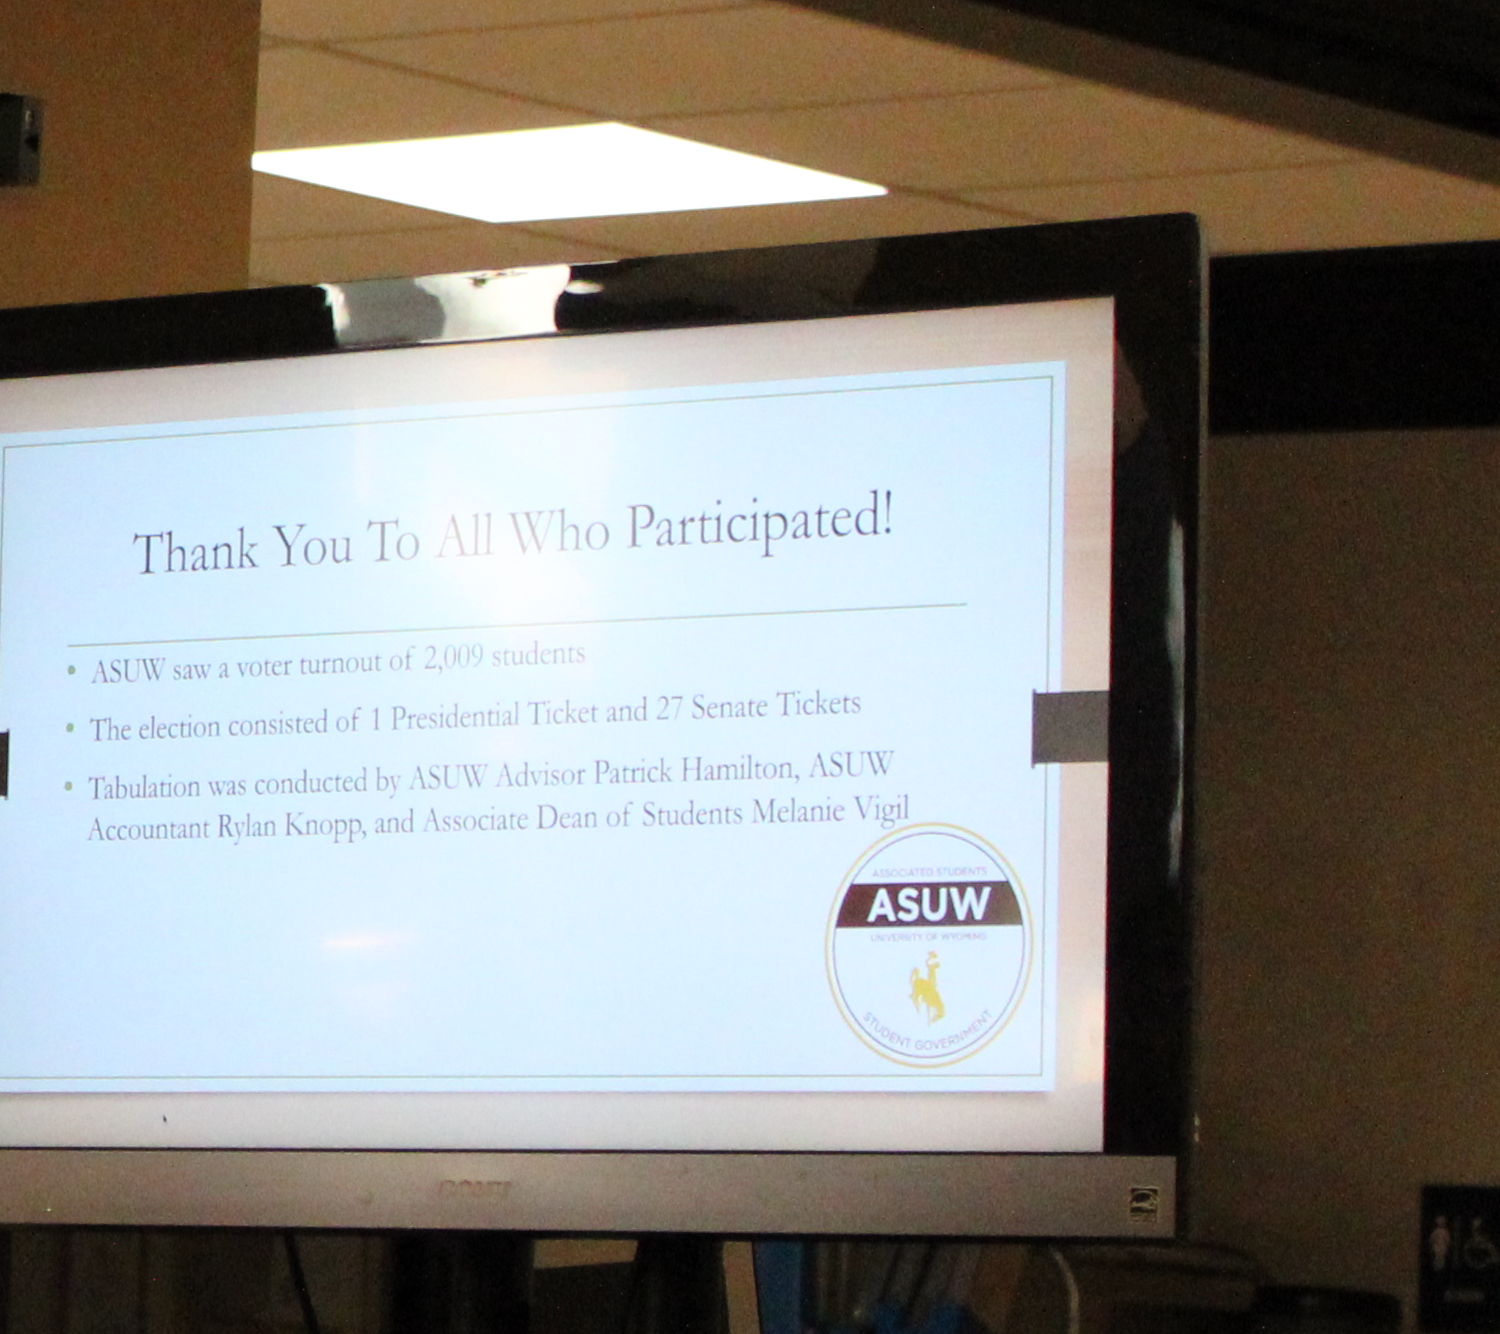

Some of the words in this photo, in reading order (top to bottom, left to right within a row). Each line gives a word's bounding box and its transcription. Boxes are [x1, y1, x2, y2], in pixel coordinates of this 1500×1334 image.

[133, 527, 259, 575] Thank
[272, 524, 353, 567] You
[366, 518, 419, 563] To
[434, 512, 494, 559] All
[508, 508, 610, 555] Who
[627, 489, 893, 558] Participated!
[91, 657, 166, 684] ASUW
[172, 662, 212, 681] saw
[218, 662, 229, 679] a
[237, 656, 293, 678] voter
[299, 652, 382, 675] turnout
[389, 646, 416, 672] of
[424, 643, 485, 673] 2,009
[492, 641, 586, 667] students
[90, 716, 131, 742] The
[138, 714, 221, 740] election
[228, 708, 328, 737] consisted
[335, 706, 361, 733] of
[370, 707, 381, 732] 1
[391, 701, 520, 730] Presidential
[527, 699, 598, 726] Ticket
[606, 696, 648, 723] and
[656, 696, 684, 722] 27
[691, 694, 768, 720] Senate
[776, 690, 862, 717] Tickets
[89, 773, 200, 800] Tabulation
[209, 779, 247, 797] was
[254, 767, 368, 795] conducted
[376, 767, 401, 799] by
[408, 763, 489, 790] ASUW
[495, 761, 585, 788] Advisor
[594, 757, 673, 785] Patrick
[681, 754, 800, 784] Hamilton,
[809, 750, 895, 779] ASUW
[88, 816, 210, 842] Accountant
[217, 813, 277, 845] Rylan
[285, 811, 367, 844] Knopp,
[374, 808, 414, 835] and
[422, 805, 528, 834] Associate
[537, 804, 598, 830] Dean
[606, 800, 633, 828] of
[642, 799, 743, 827] Students
[752, 796, 845, 824] Melanie
[853, 794, 910, 829] Vigil
[872, 868, 934, 879] ASSOCIATED
[936, 866, 988, 878] STUDENTS
[867, 886, 991, 923] ASUW
[870, 932, 924, 943] UNIVERSITY
[863, 1011, 912, 1048] STUDENT
[914, 1009, 993, 1051] GOVERNMENT
